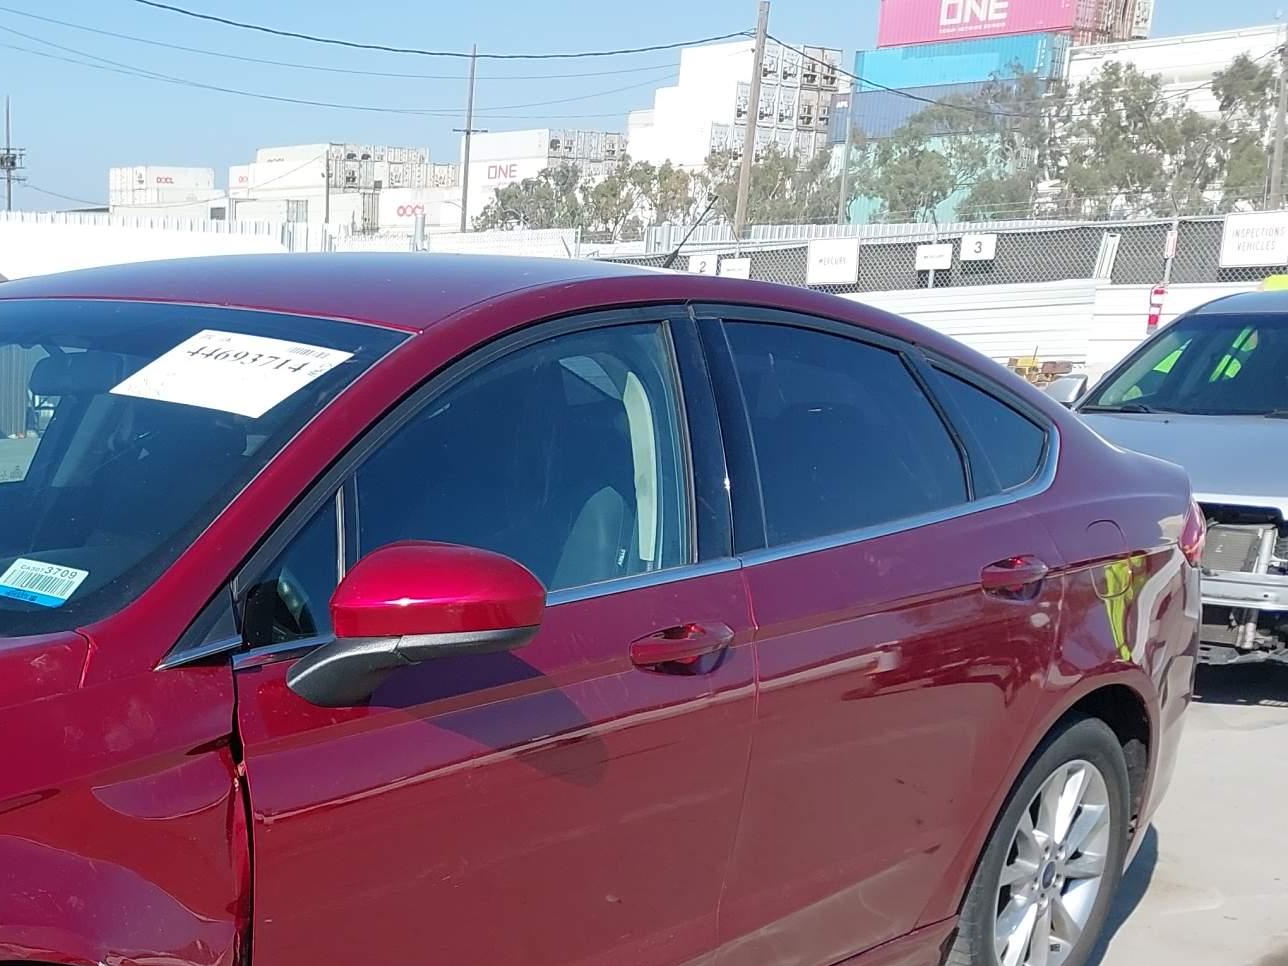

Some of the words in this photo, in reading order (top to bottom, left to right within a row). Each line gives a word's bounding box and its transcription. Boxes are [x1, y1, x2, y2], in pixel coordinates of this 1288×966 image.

[940, 0, 1009, 26] ONE
[487, 163, 519, 180] ONE
[1232, 226, 1286, 239] INSPECTIONS
[973, 241, 983, 254] 3
[1237, 240, 1276, 252] VEHICLES
[699, 260, 707, 273] 2
[186, 345, 311, 373] 44693714
